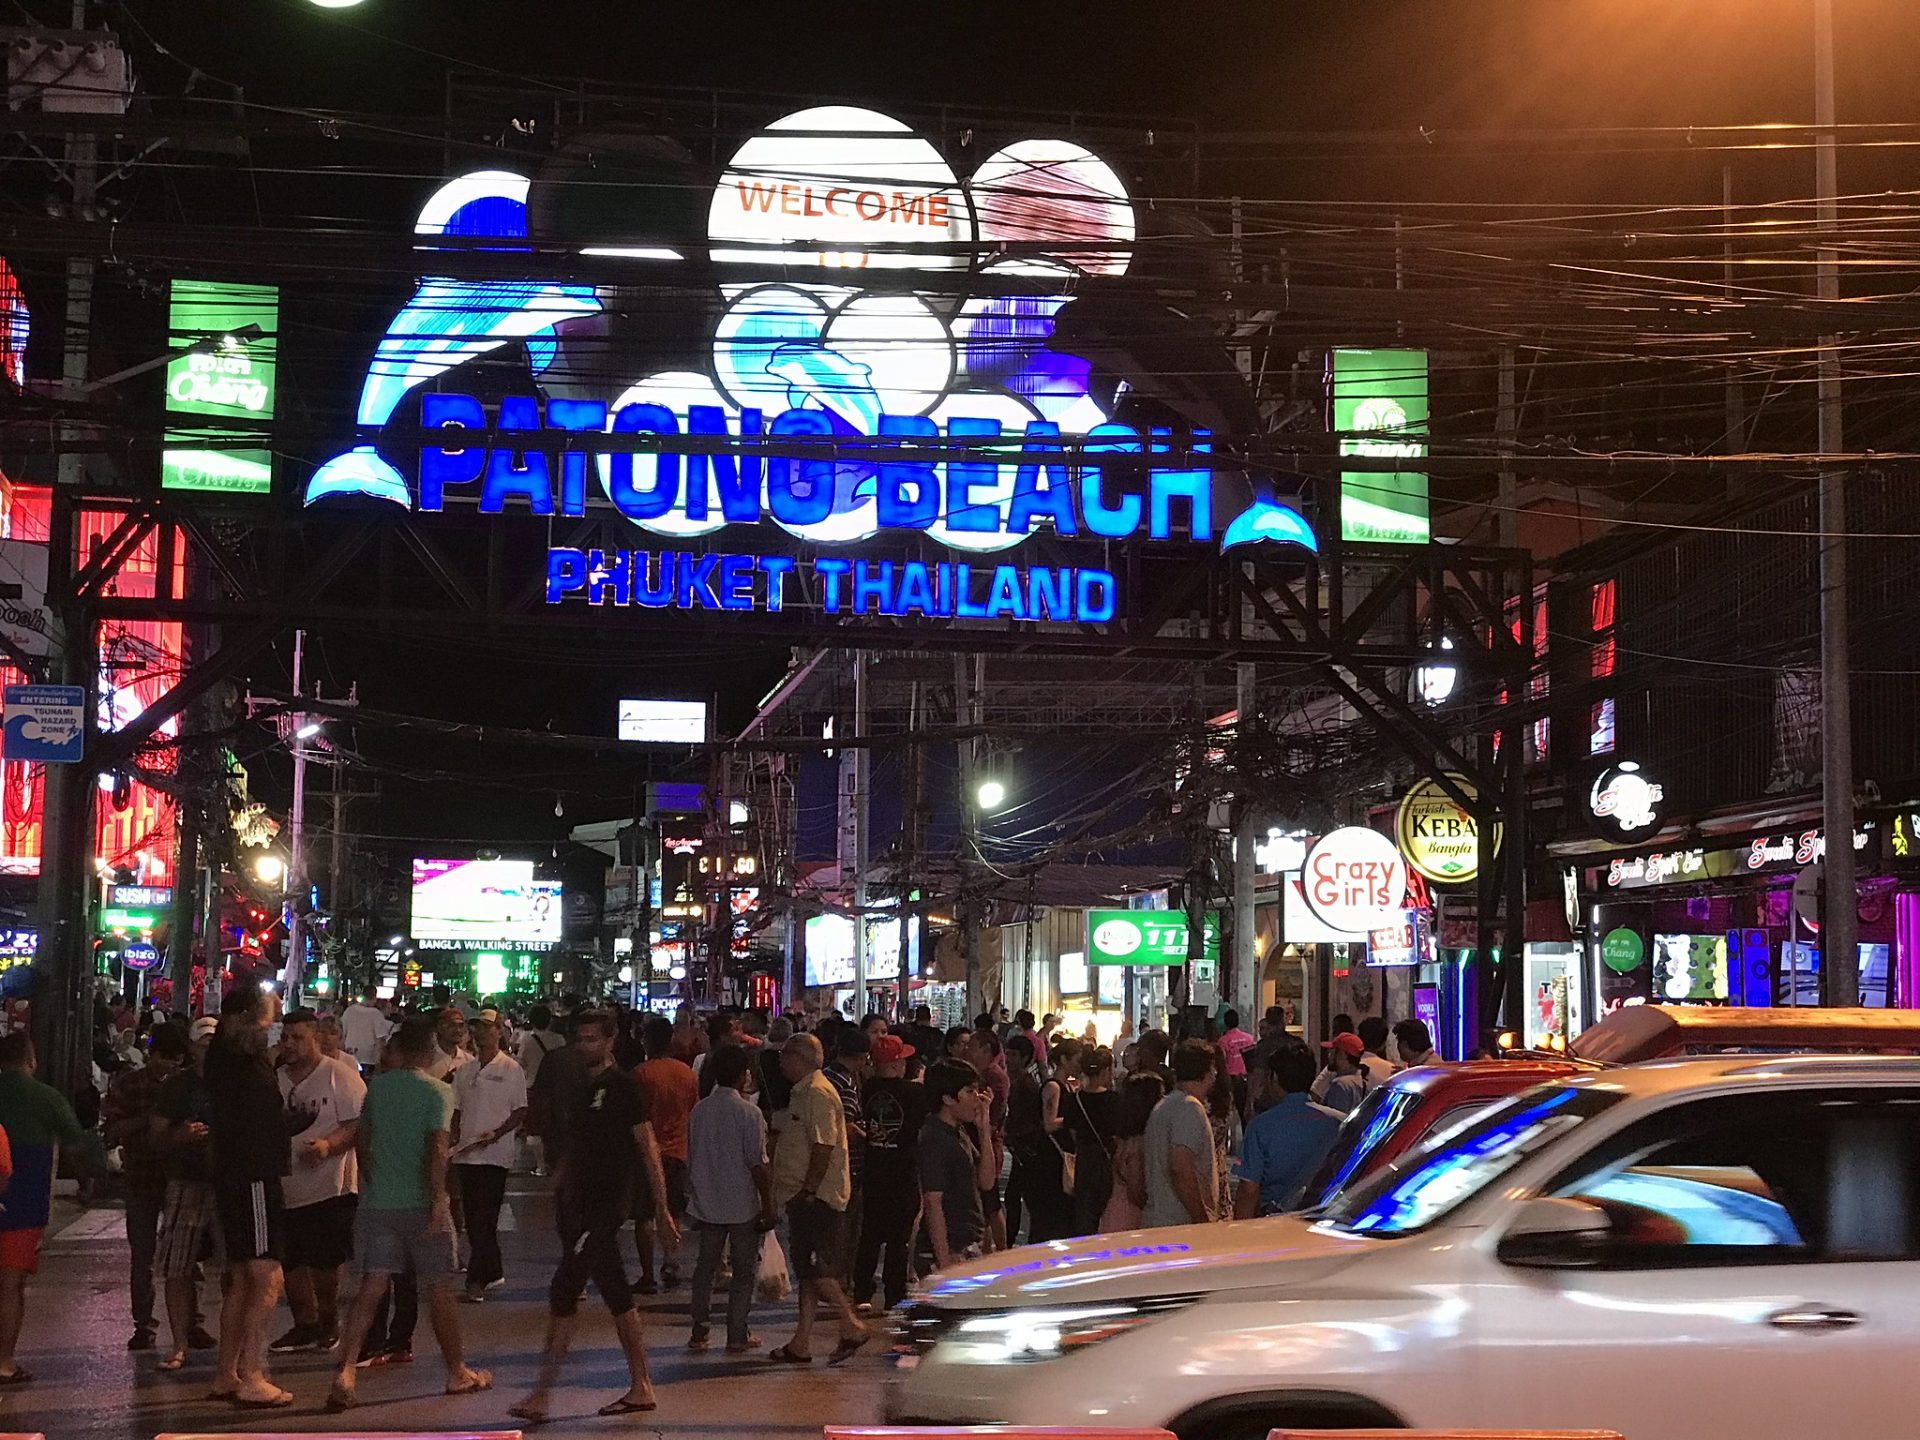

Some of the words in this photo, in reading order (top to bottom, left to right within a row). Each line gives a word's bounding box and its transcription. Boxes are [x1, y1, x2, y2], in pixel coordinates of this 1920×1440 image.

[737, 181, 950, 227] WELCOME
[419, 393, 835, 527] PATONG
[876, 413, 1212, 542] BEACH
[546, 547, 794, 612] PHUKET
[814, 558, 1116, 623] THAILAND
[20, 696, 68, 705] ENTERING
[34, 707, 73, 715] TSUNAMI
[41, 717, 77, 725] HAZARD
[1411, 815, 1478, 838] KEBA
[1428, 842, 1472, 857] Bangla
[1313, 853, 1395, 889] Crazy
[115, 887, 151, 904] SUSHI
[1314, 878, 1391, 906] Girls
[418, 939, 462, 950] BANGLA
[464, 941, 513, 951] WALKING
[517, 942, 554, 952] STREET
[1603, 946, 1636, 961] Chang
